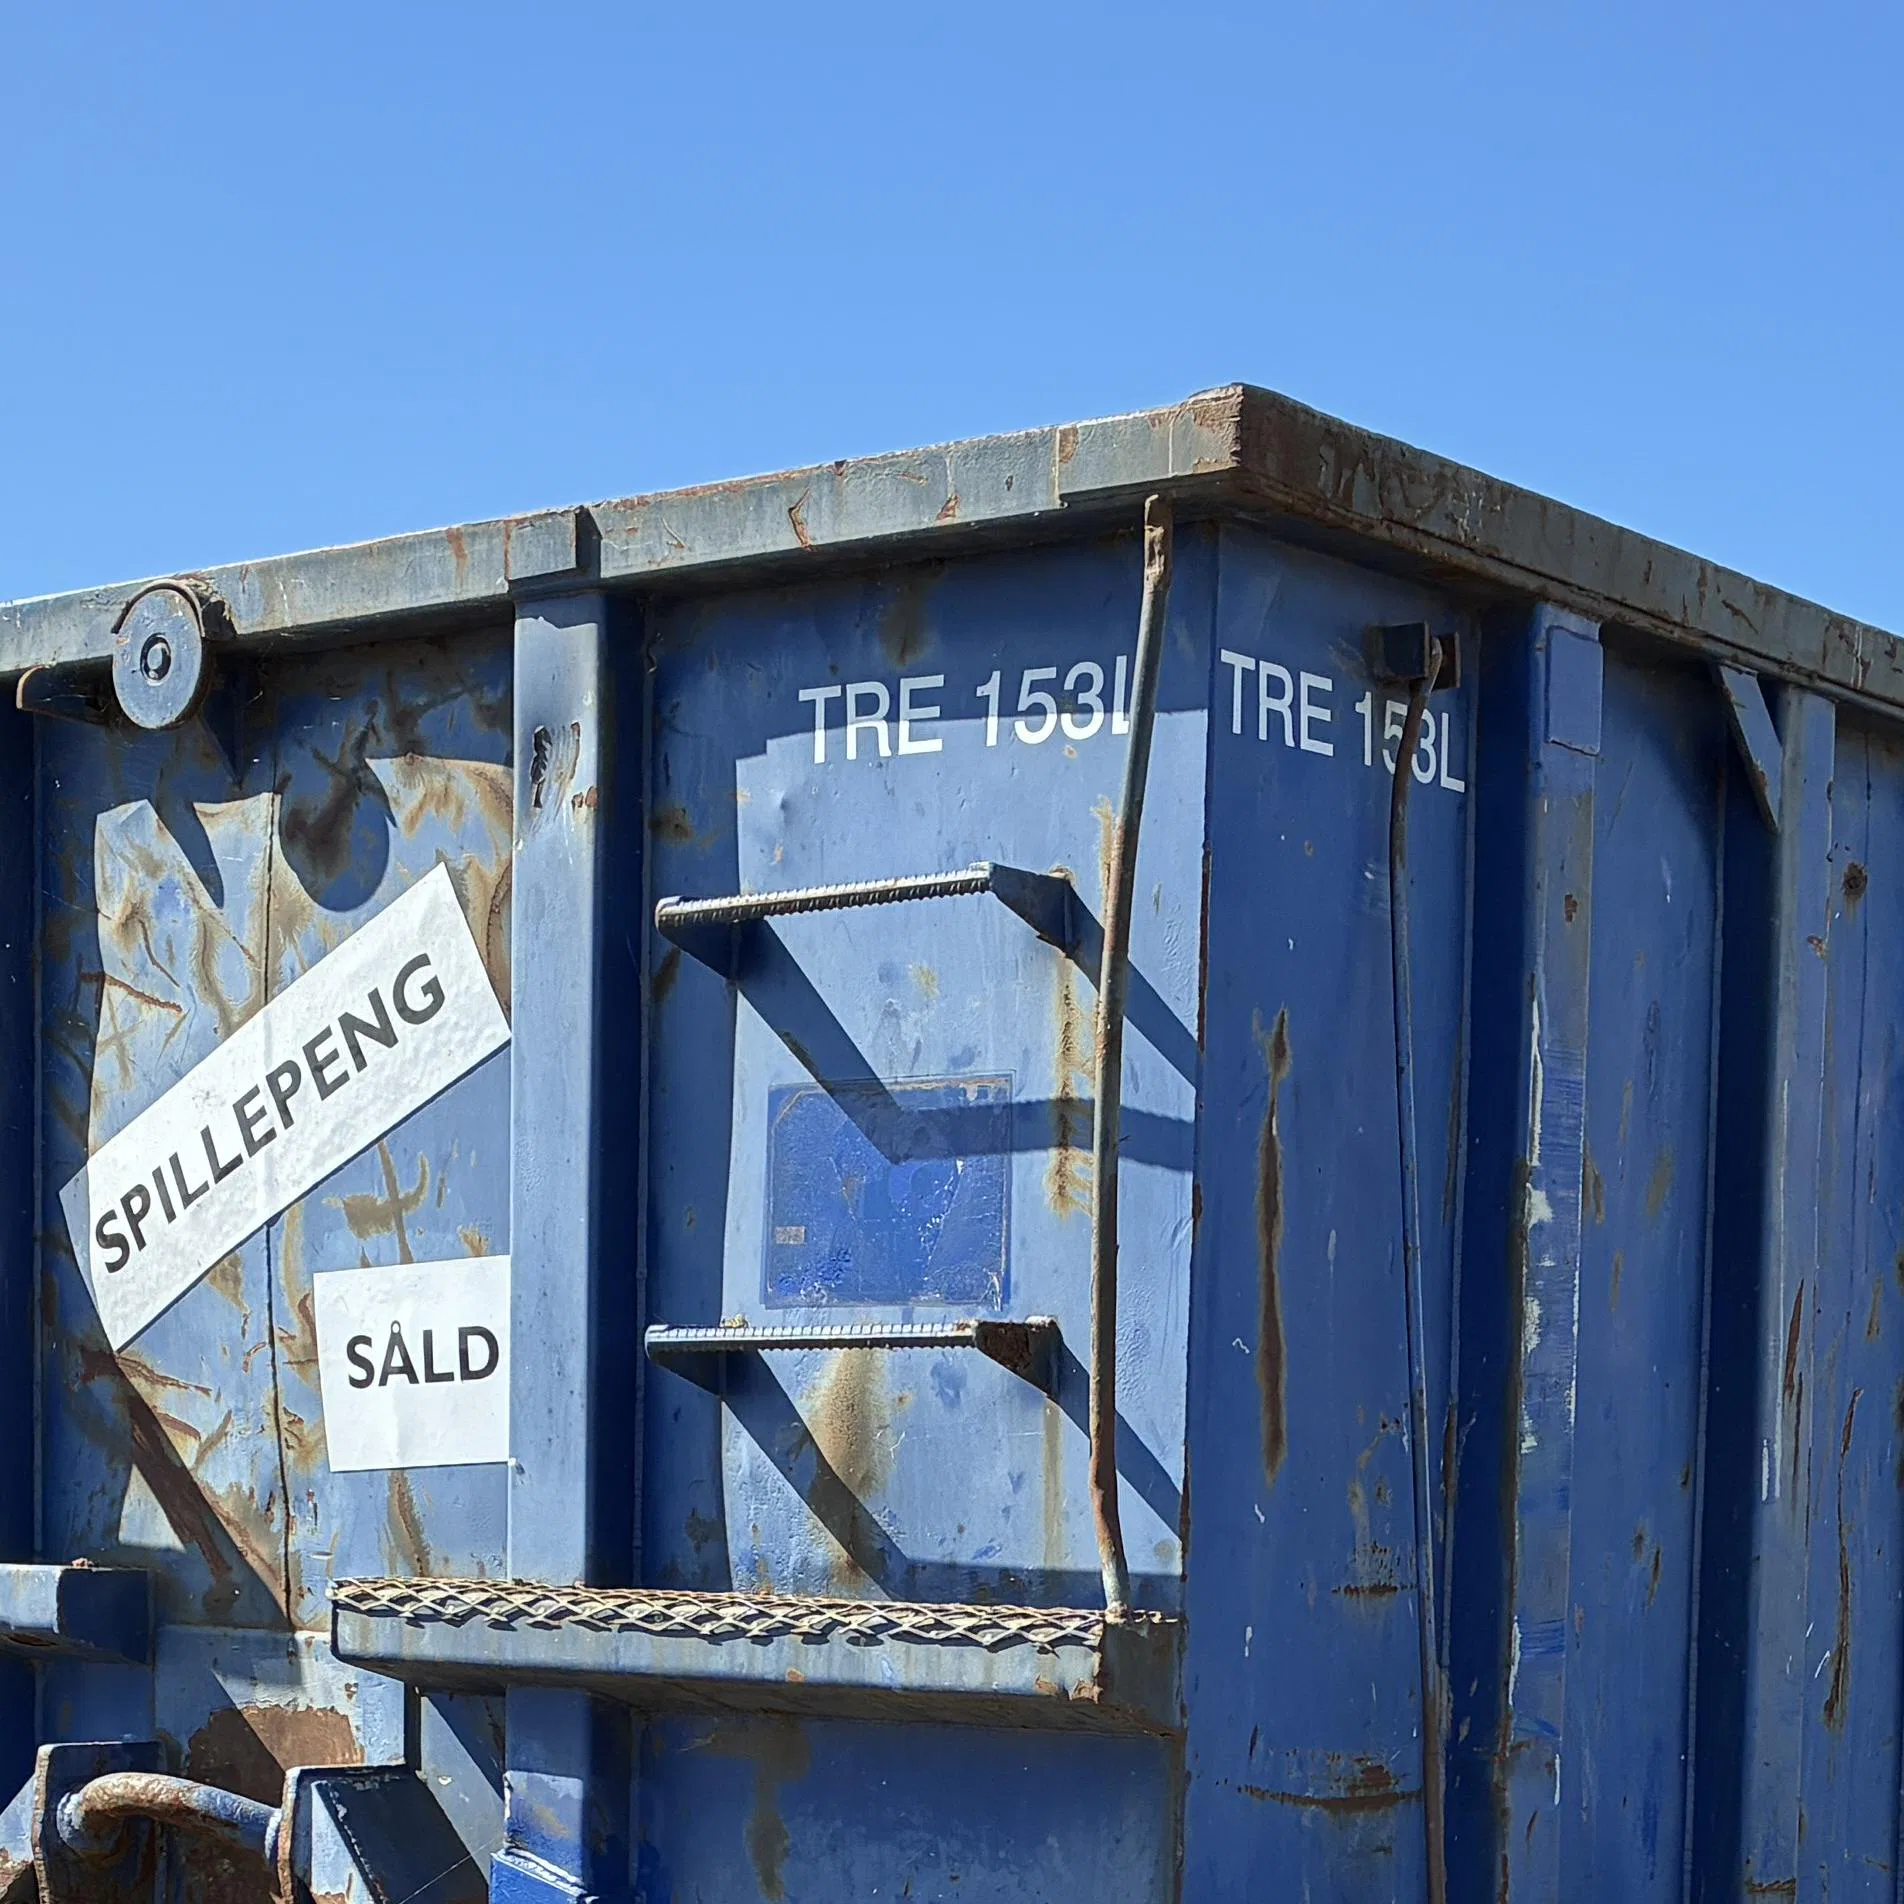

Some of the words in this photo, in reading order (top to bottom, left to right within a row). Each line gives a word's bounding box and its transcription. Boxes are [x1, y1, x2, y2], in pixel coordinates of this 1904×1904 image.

[798, 673, 945, 764] TRE
[1220, 648, 1334, 757] TRE
[1354, 691, 1465, 794] 153L
[96, 952, 446, 1274] SPILLEPENG
[346, 1320, 499, 1389] SÅLD
